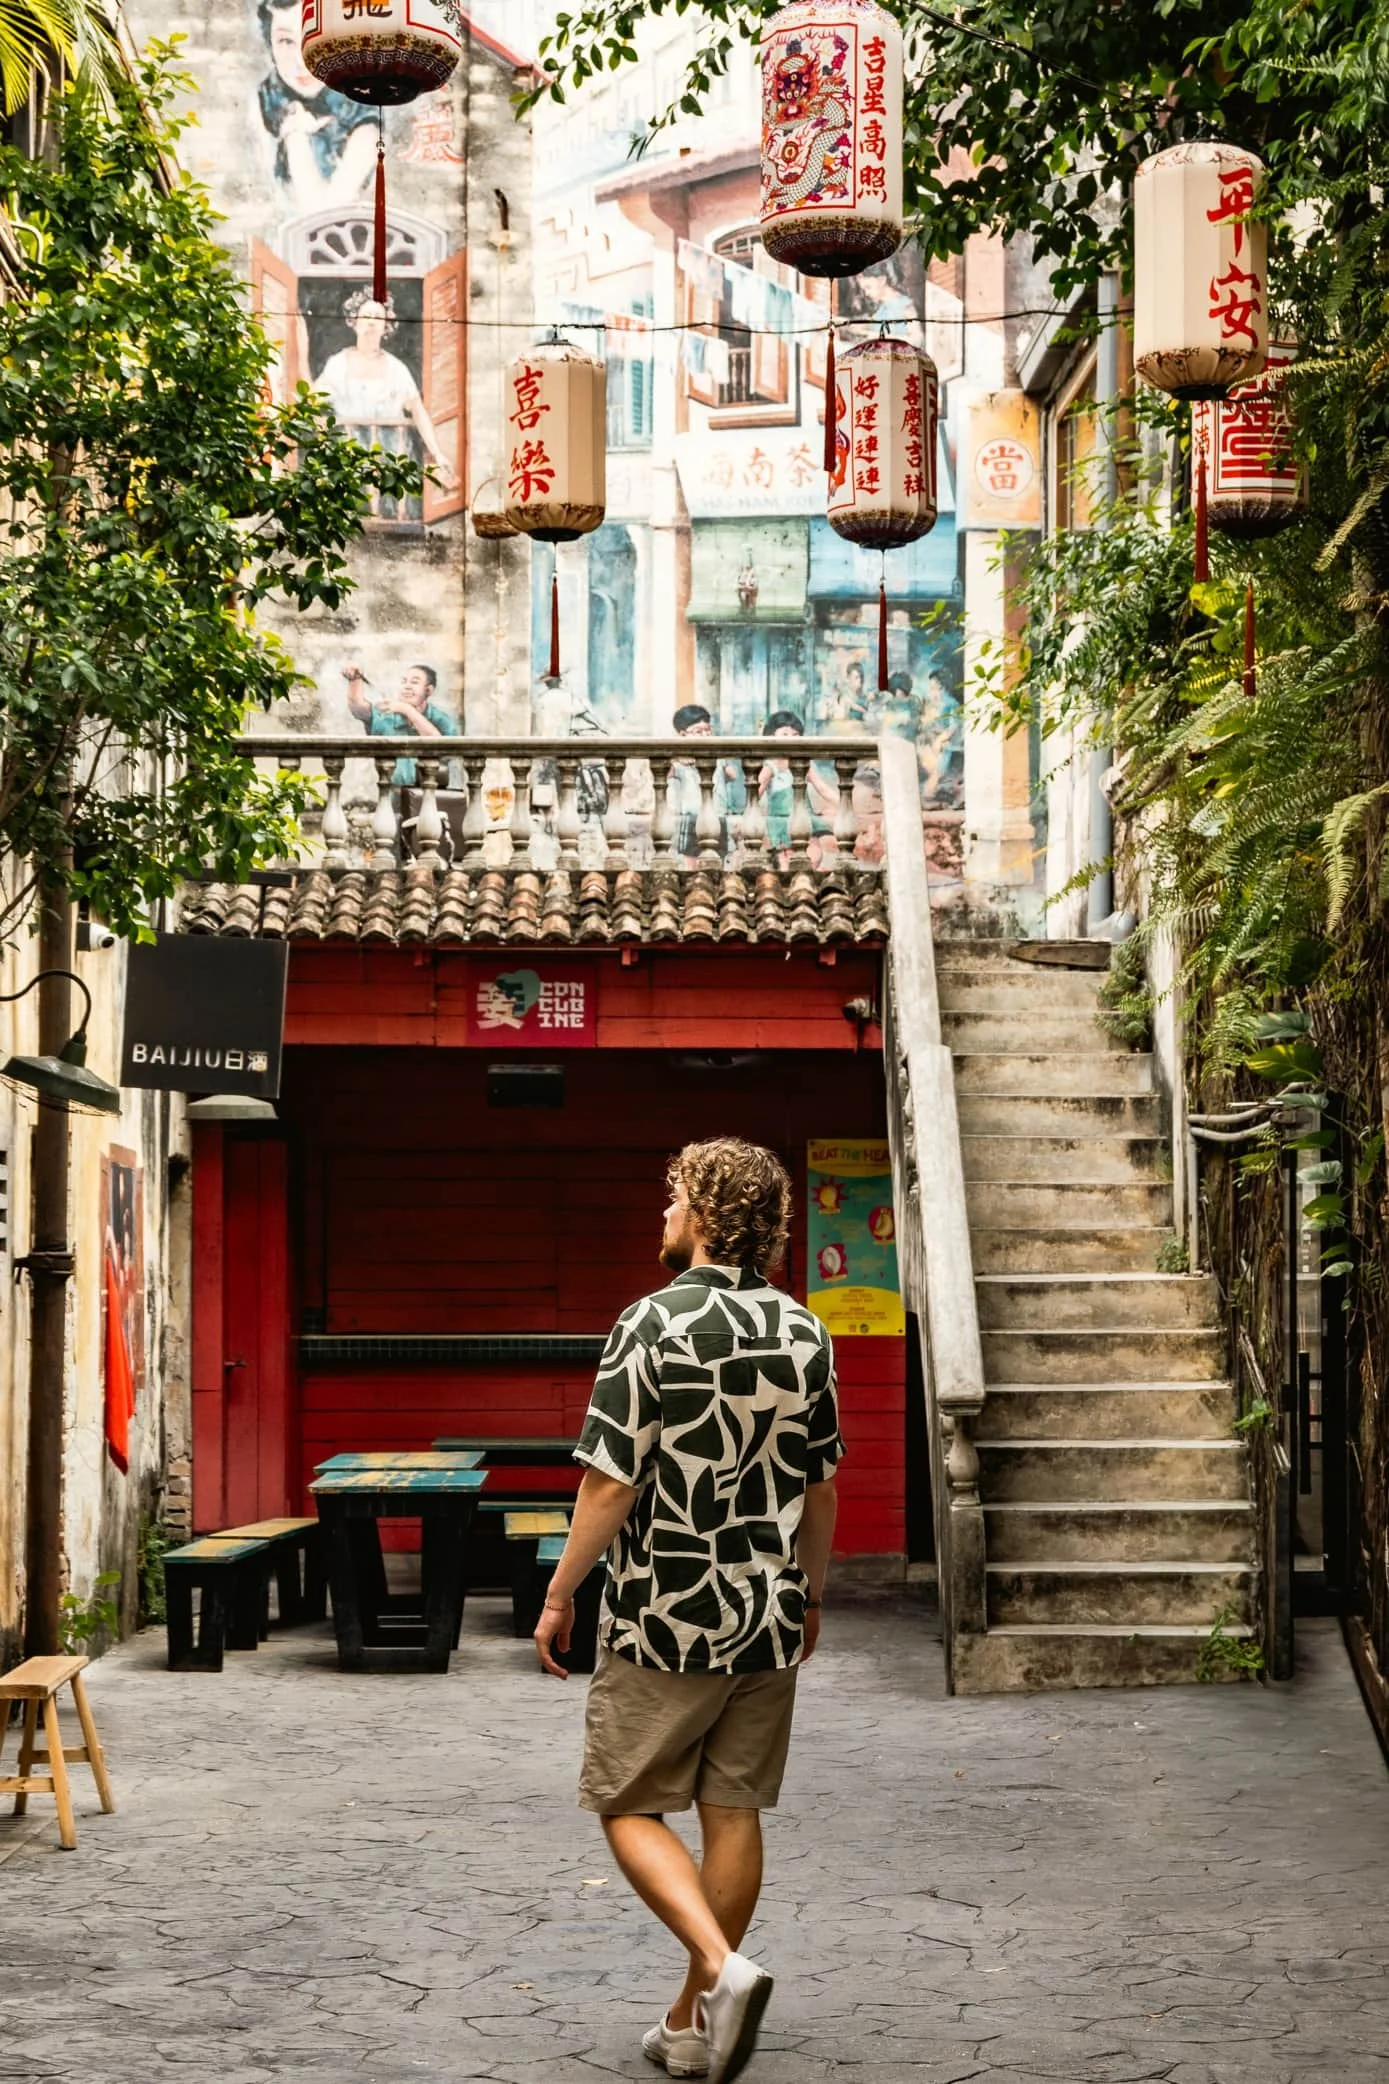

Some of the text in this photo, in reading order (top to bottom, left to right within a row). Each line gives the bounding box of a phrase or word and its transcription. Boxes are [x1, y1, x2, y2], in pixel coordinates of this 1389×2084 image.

[857, 36, 888, 204] 吉星高照
[1206, 167, 1261, 349] 平安
[508, 365, 556, 503] 喜樂
[900, 373, 926, 497] 喜慶吉祥
[981, 445, 1024, 491] 當
[811, 1147, 838, 1162] BEAT
[863, 1148, 890, 1162] HEA
